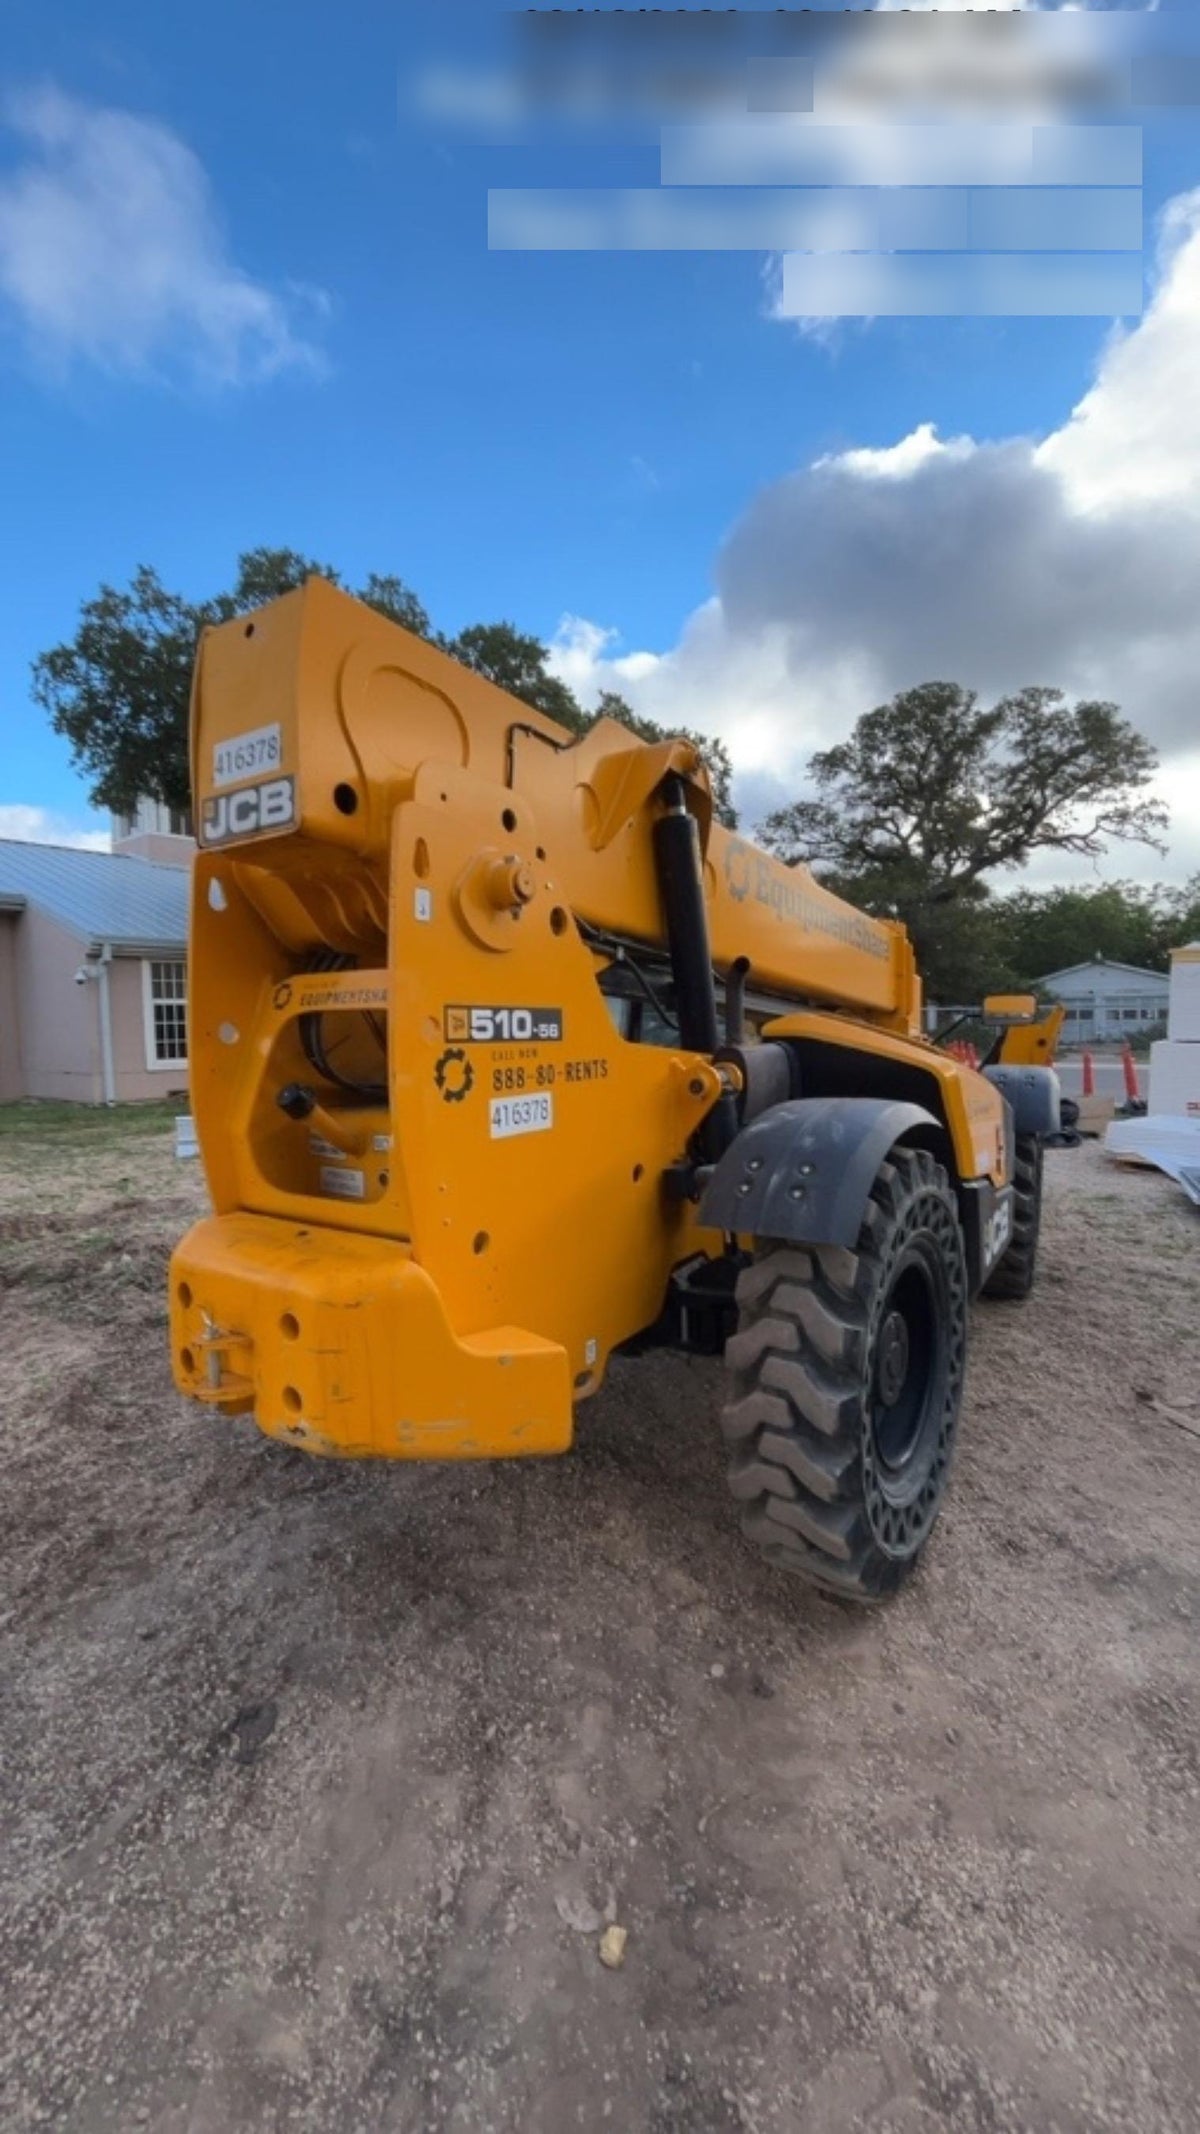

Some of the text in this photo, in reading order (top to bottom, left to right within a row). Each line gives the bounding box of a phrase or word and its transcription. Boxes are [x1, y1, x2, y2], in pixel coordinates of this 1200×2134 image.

[215, 735, 278, 775] 416378
[203, 779, 293, 840] JCB
[493, 1058, 608, 1092] 888-80-RENTS
[492, 1098, 550, 1128] 416378
